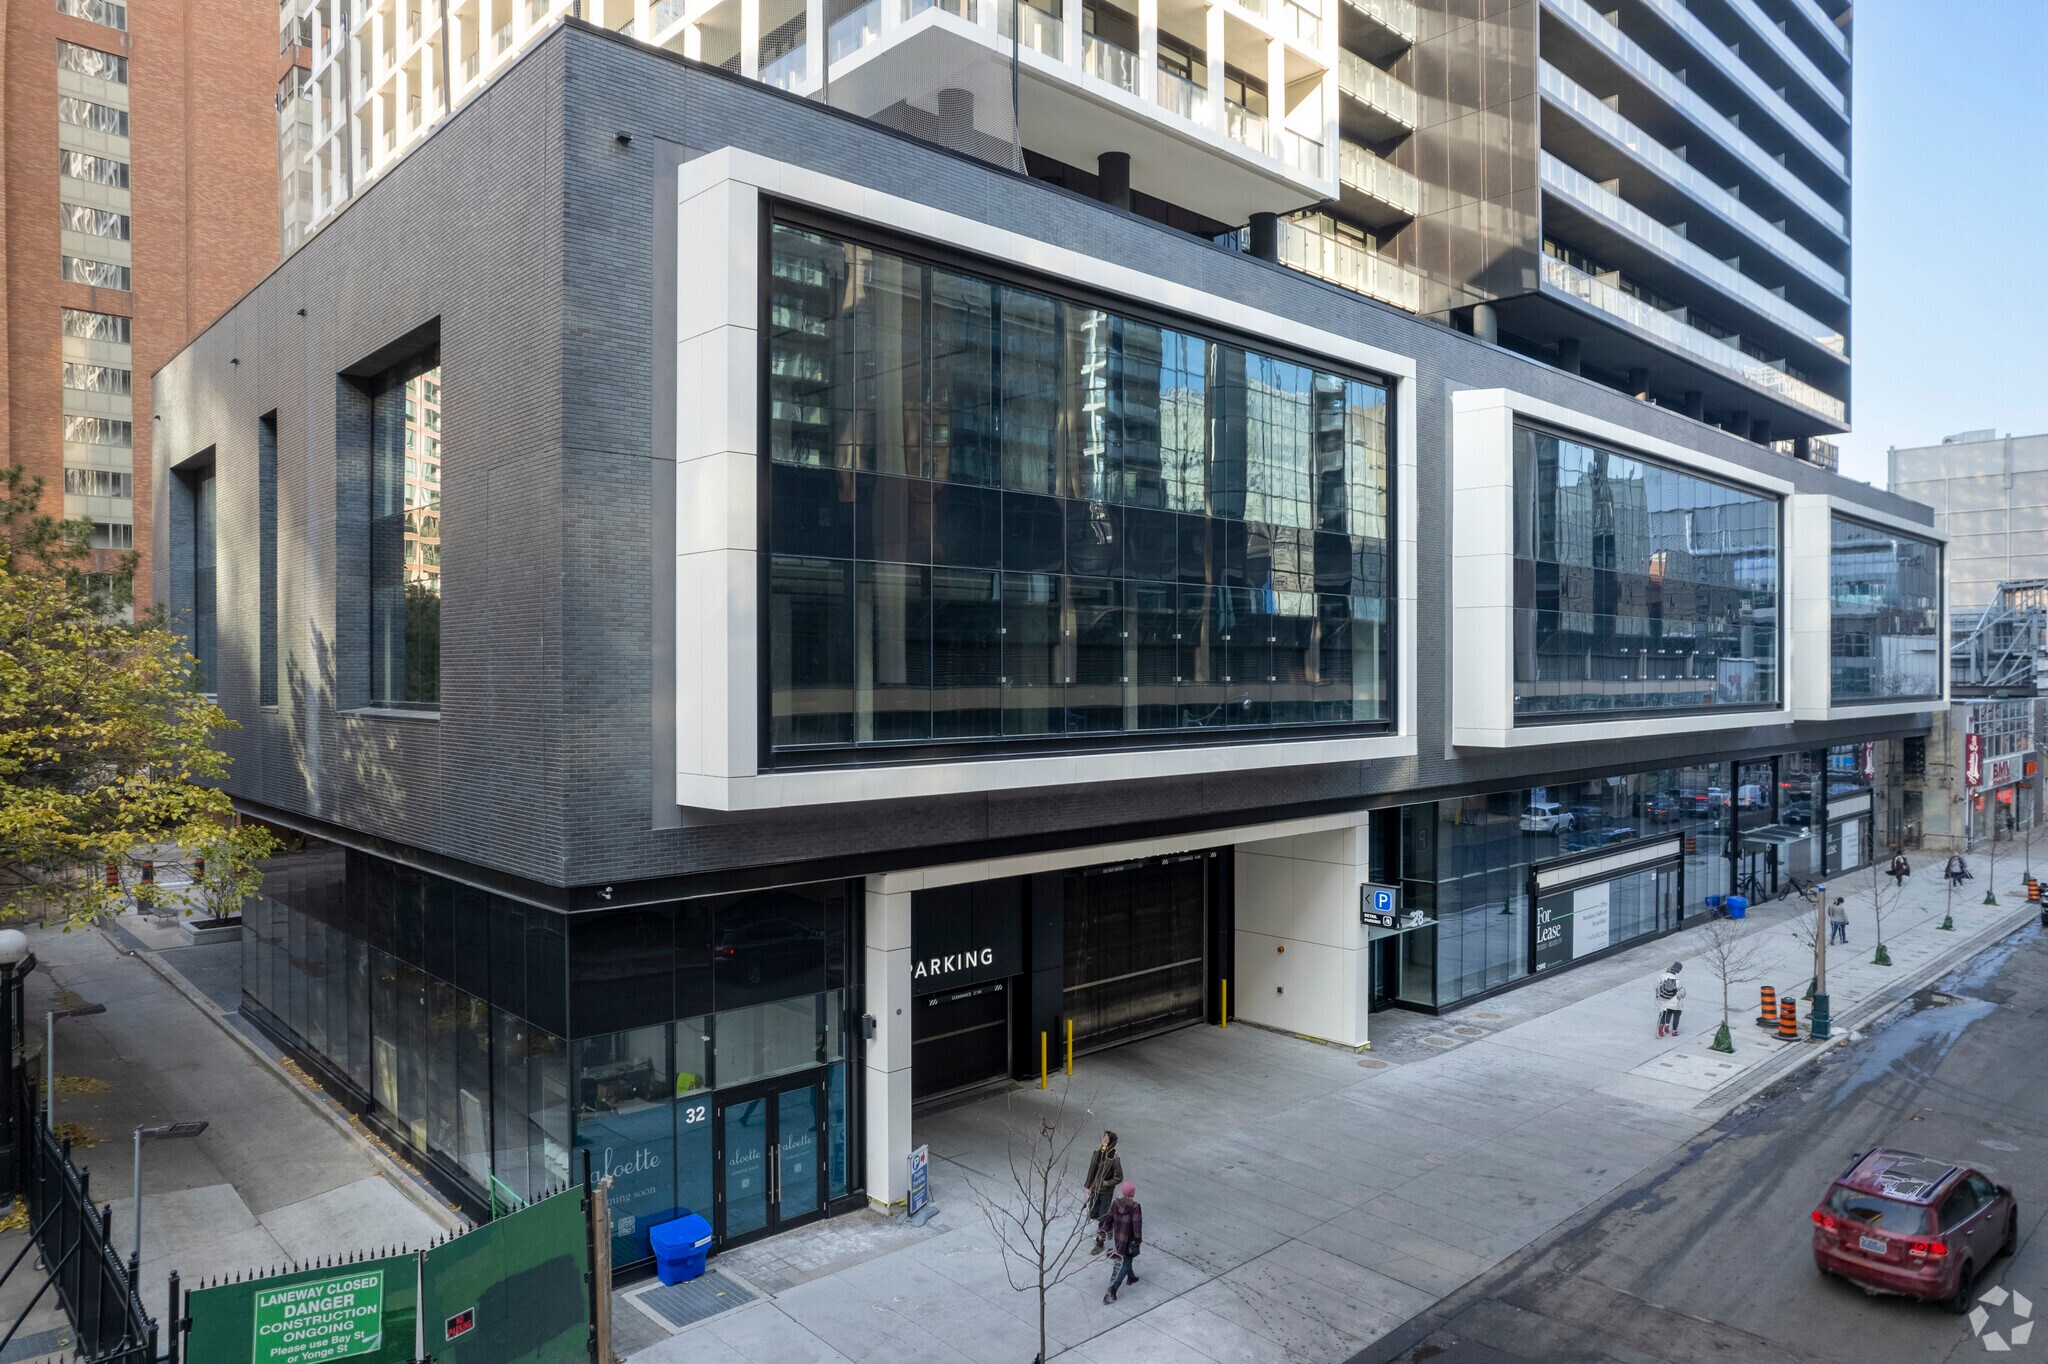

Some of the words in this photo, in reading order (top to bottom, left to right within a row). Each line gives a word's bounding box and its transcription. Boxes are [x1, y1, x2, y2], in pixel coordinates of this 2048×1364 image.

[1379, 893, 1388, 908] P
[1410, 910, 1424, 927] 28
[1537, 907, 1552, 925] For
[1537, 924, 1561, 943] Lease
[910, 948, 993, 979] ARKING
[686, 1106, 705, 1124] 32
[783, 1134, 812, 1151] aloette
[591, 1147, 661, 1184] aloette
[729, 1148, 761, 1166] aloette
[607, 1193, 631, 1206] ming
[633, 1186, 656, 1199] soon
[260, 1286, 324, 1307] LANEWAY
[327, 1276, 378, 1295] CLOSED
[284, 1293, 355, 1318] DANGER
[260, 1304, 377, 1335] CONSTRUCTION
[448, 1320, 472, 1336] PARKING
[456, 1314, 464, 1325] NO
[283, 1320, 354, 1343] ONGOING
[270, 1343, 306, 1357] Please
[309, 1338, 328, 1349] use
[331, 1334, 351, 1345] Bay
[354, 1330, 365, 1340] St
[287, 1354, 299, 1364] or
[302, 1347, 334, 1361] Yonge
[337, 1344, 348, 1354] St
